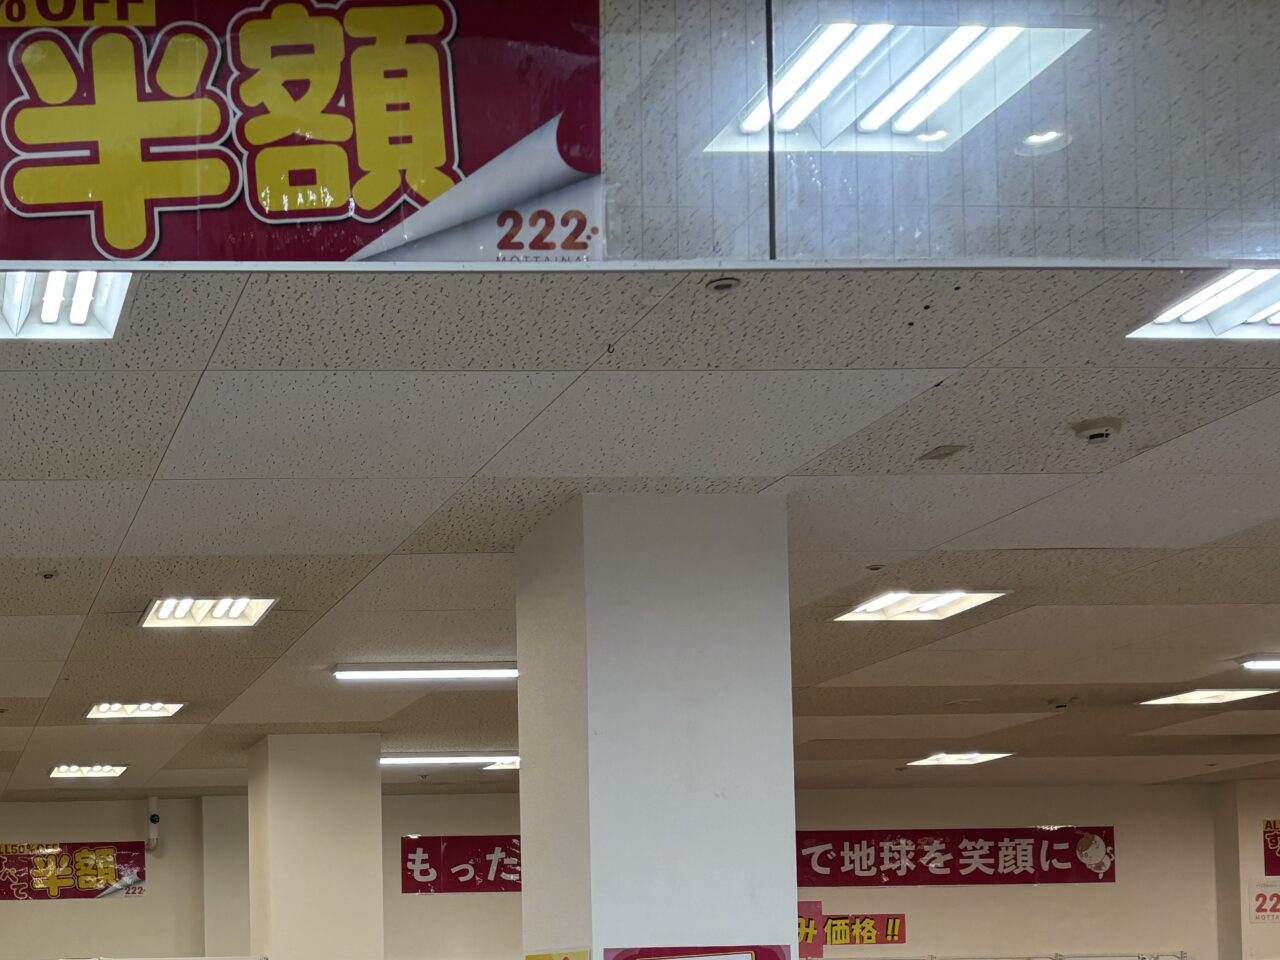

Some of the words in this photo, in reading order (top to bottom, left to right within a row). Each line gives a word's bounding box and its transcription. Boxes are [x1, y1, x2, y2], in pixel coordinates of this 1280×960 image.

[1, 0, 465, 261] 半額
[31, 847, 118, 898] 半額
[801, 838, 1072, 877] で地球を笑顔に
